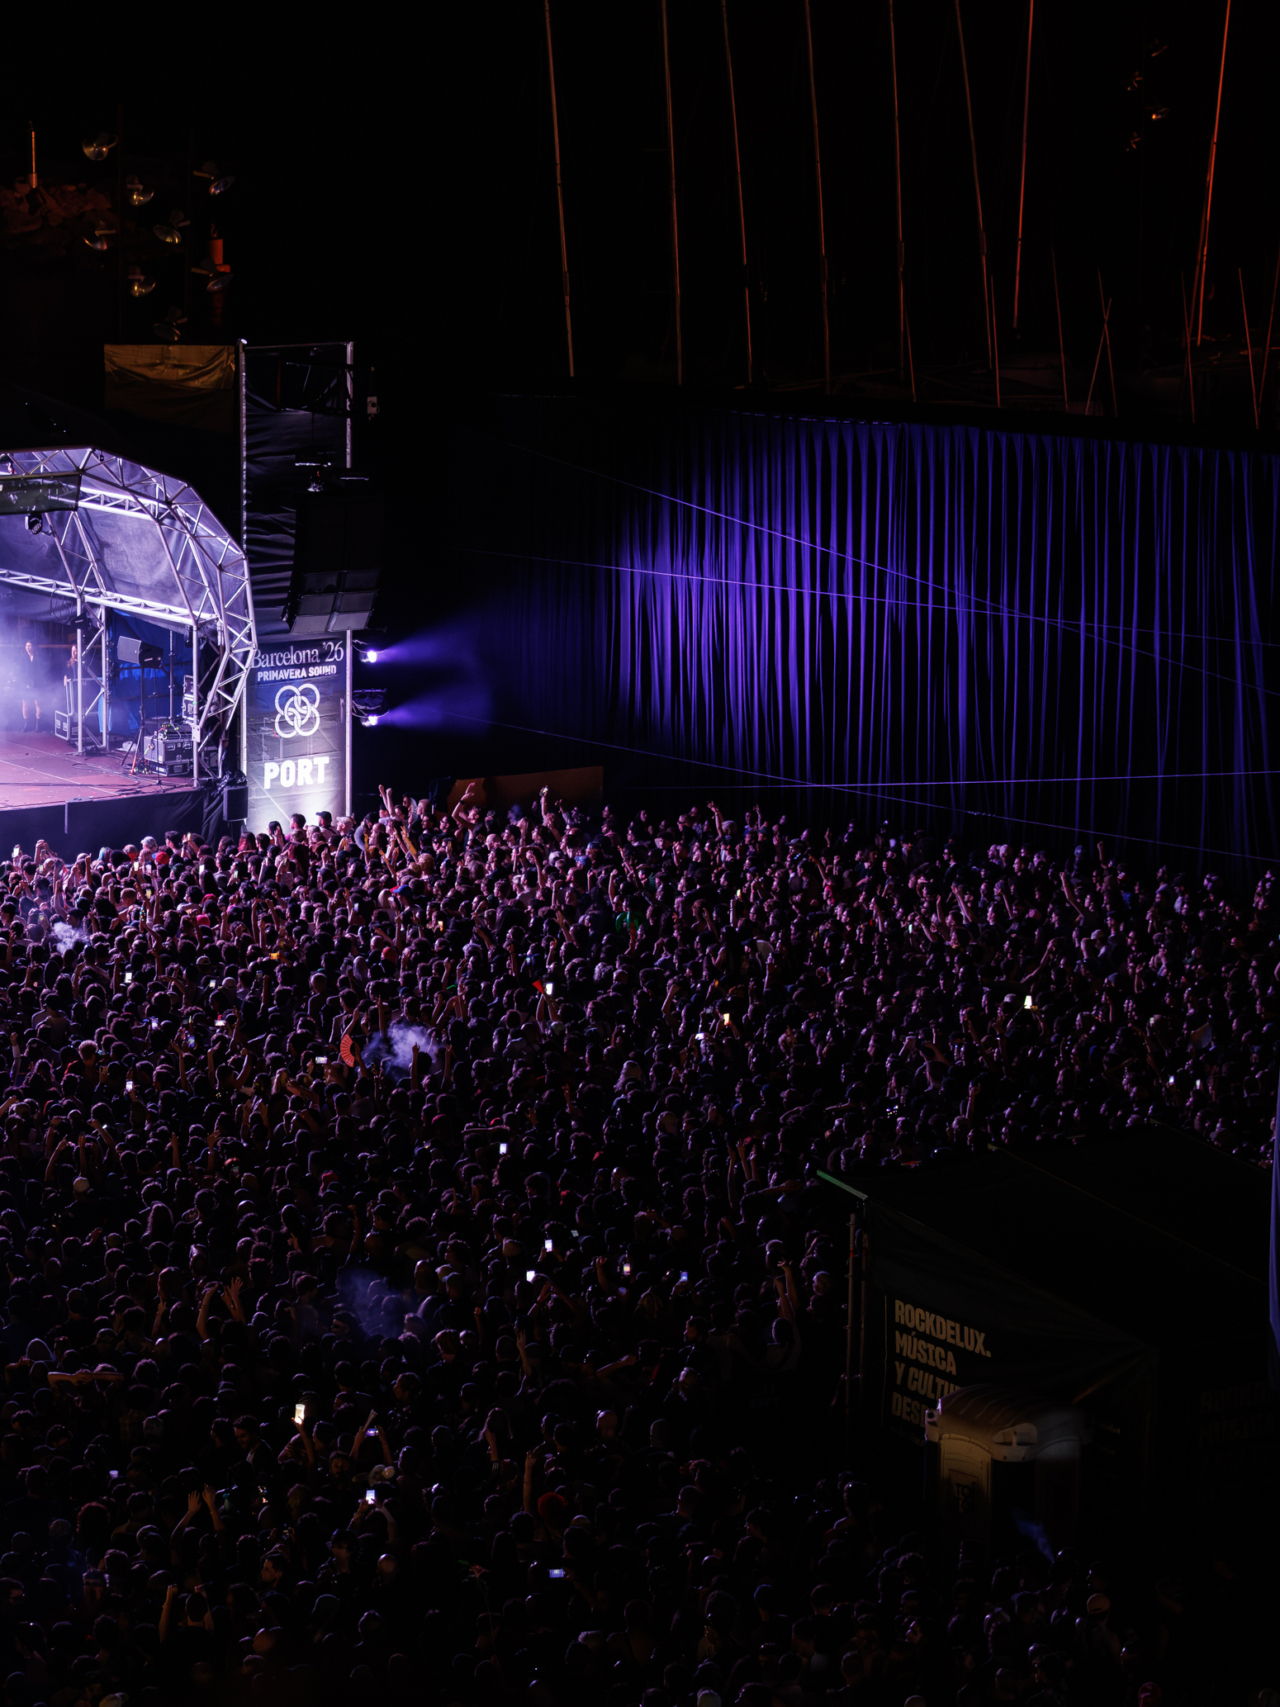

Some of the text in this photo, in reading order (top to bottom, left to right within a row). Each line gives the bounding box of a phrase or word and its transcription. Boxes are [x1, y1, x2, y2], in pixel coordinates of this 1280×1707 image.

[251, 645, 320, 669] Barcelona
[257, 665, 337, 682] PRIMAVERA SOUND
[263, 756, 329, 790] PORT
[894, 1299, 992, 1358] ROCKDELUX.
[895, 1330, 957, 1376] MÚSICA
[894, 1360, 962, 1401] Y CULTU
